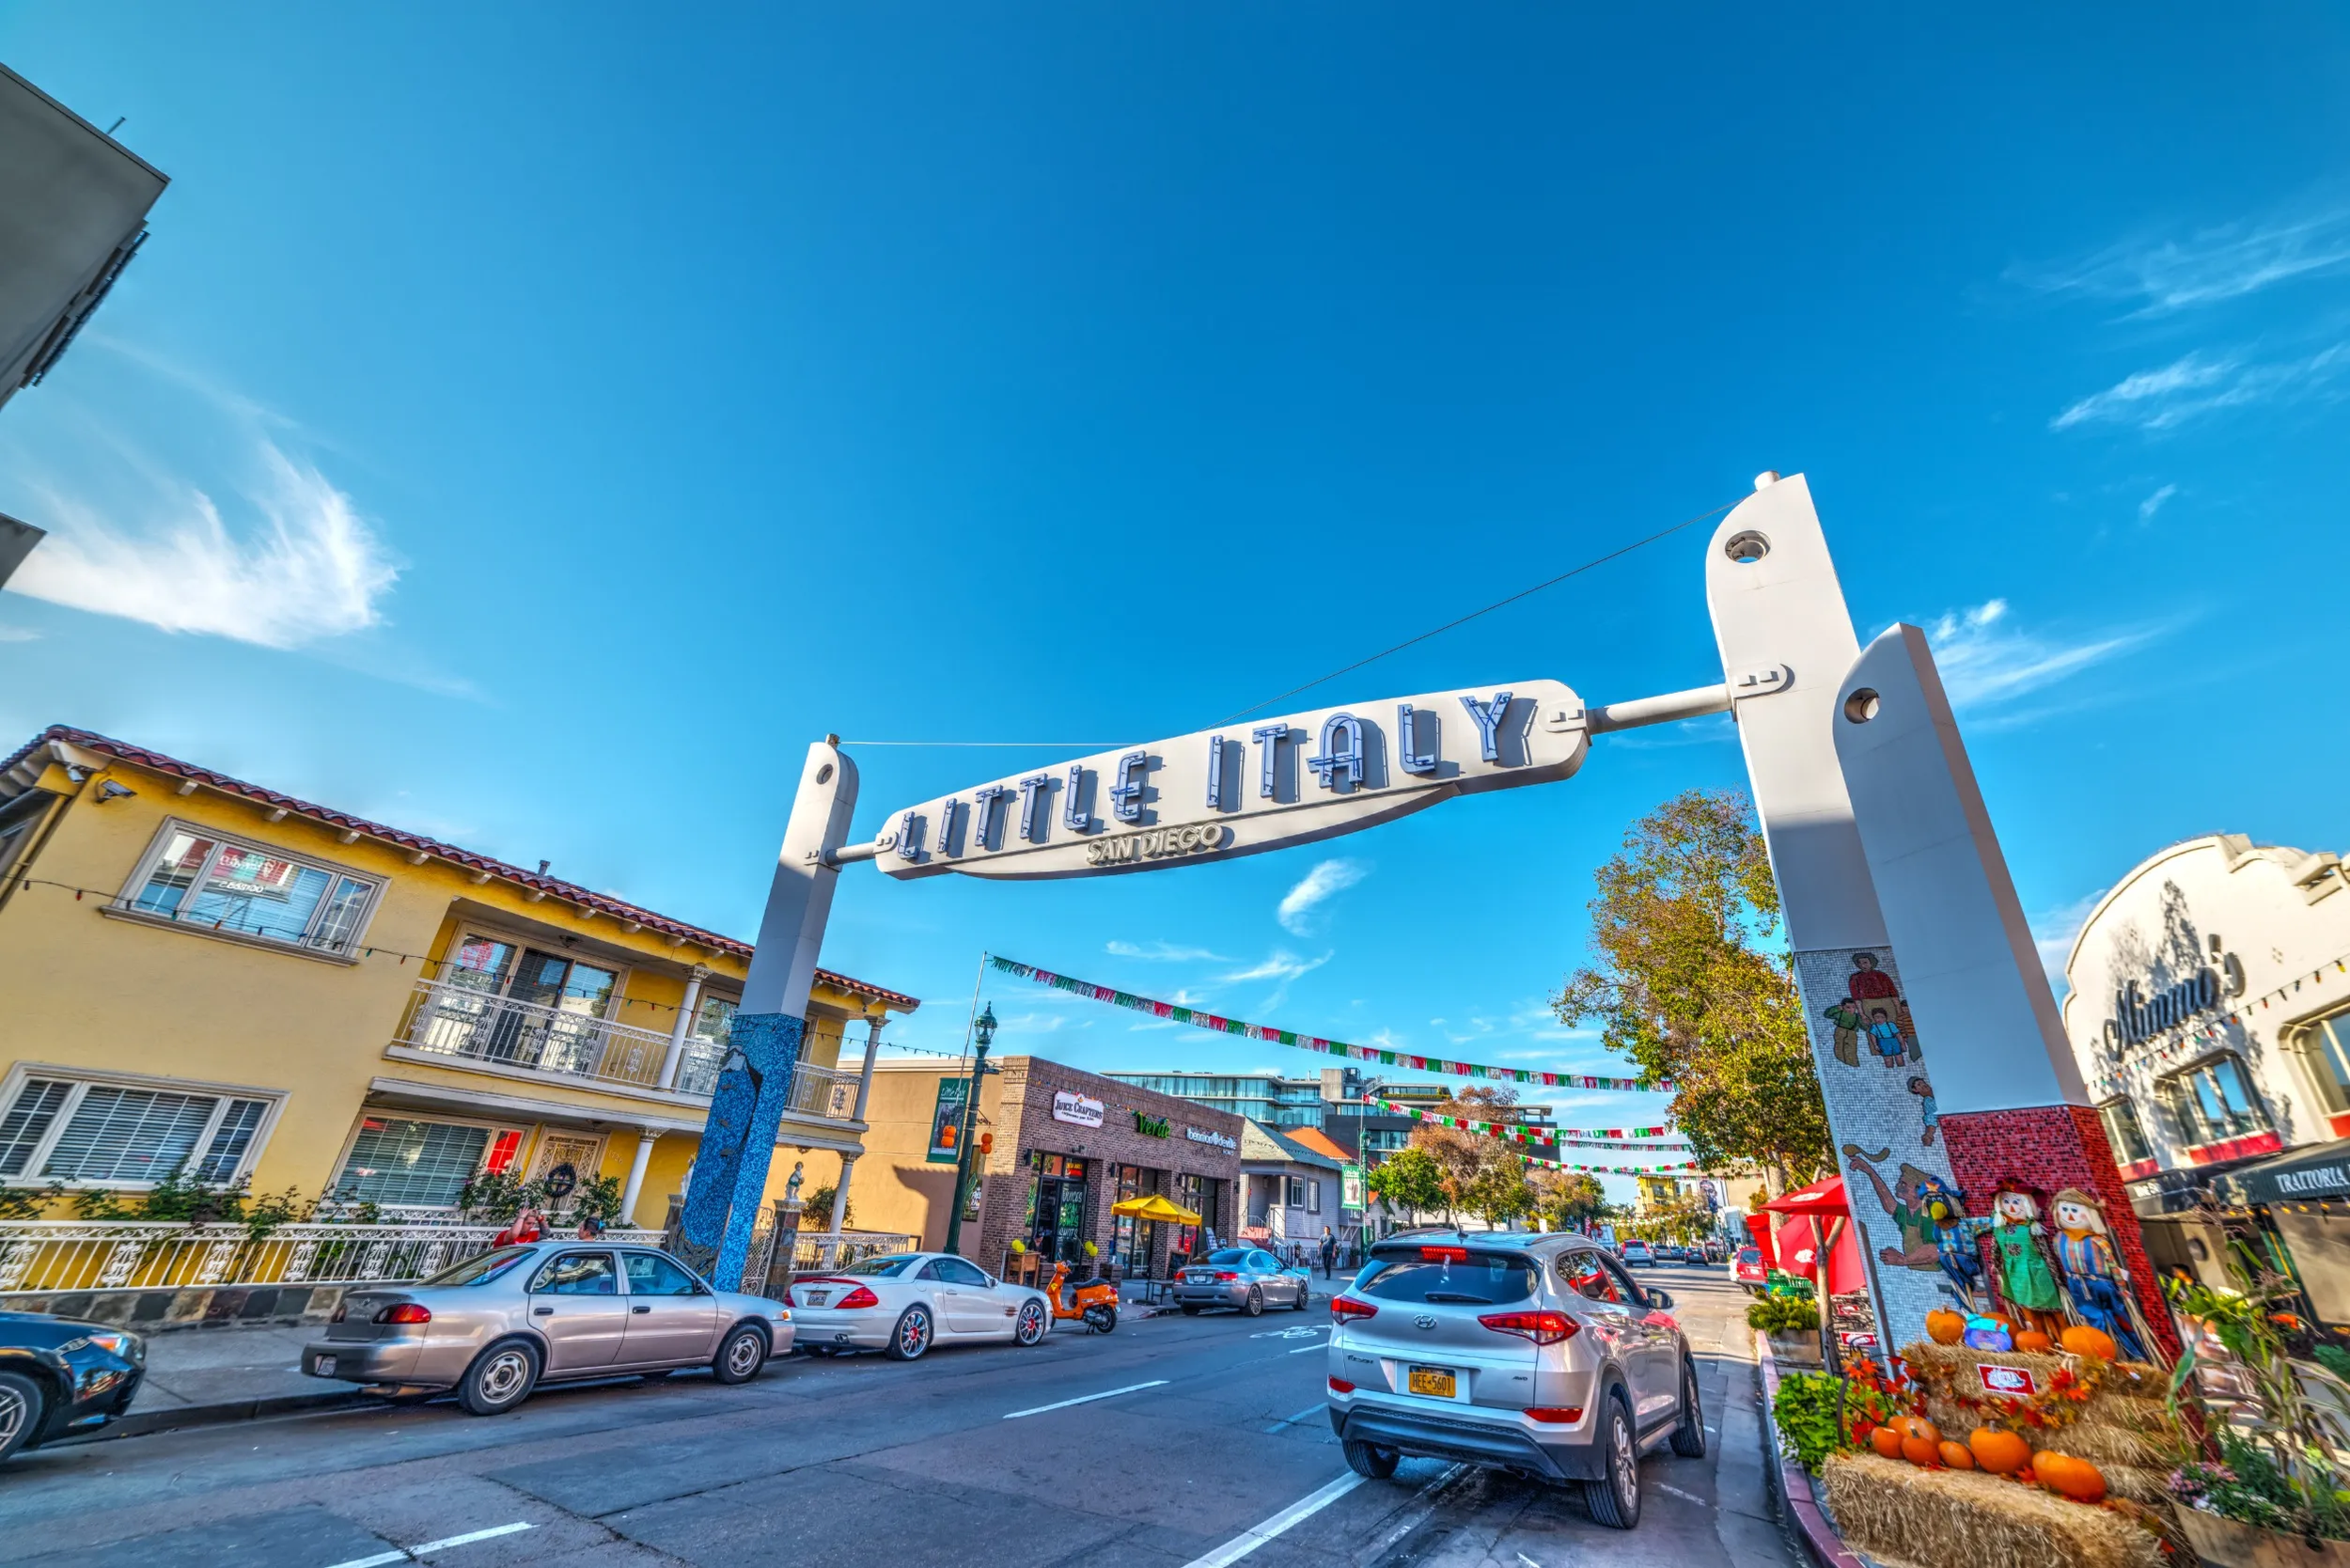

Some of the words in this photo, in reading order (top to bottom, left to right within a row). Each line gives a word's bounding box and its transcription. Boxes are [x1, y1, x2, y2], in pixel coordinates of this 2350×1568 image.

[898, 750, 1146, 860] LITTLE
[1206, 691, 1513, 808] ITALY
[1086, 837, 1135, 865] SAN
[1139, 821, 1223, 856] DIEGO
[2104, 933, 2246, 1062] Mimmo's
[1056, 1099, 1073, 1111] JUICE
[1073, 1102, 1103, 1120] CRAFTERS
[1136, 1111, 1170, 1138] Verde
[2275, 1166, 2349, 1193] TRATTORIA
